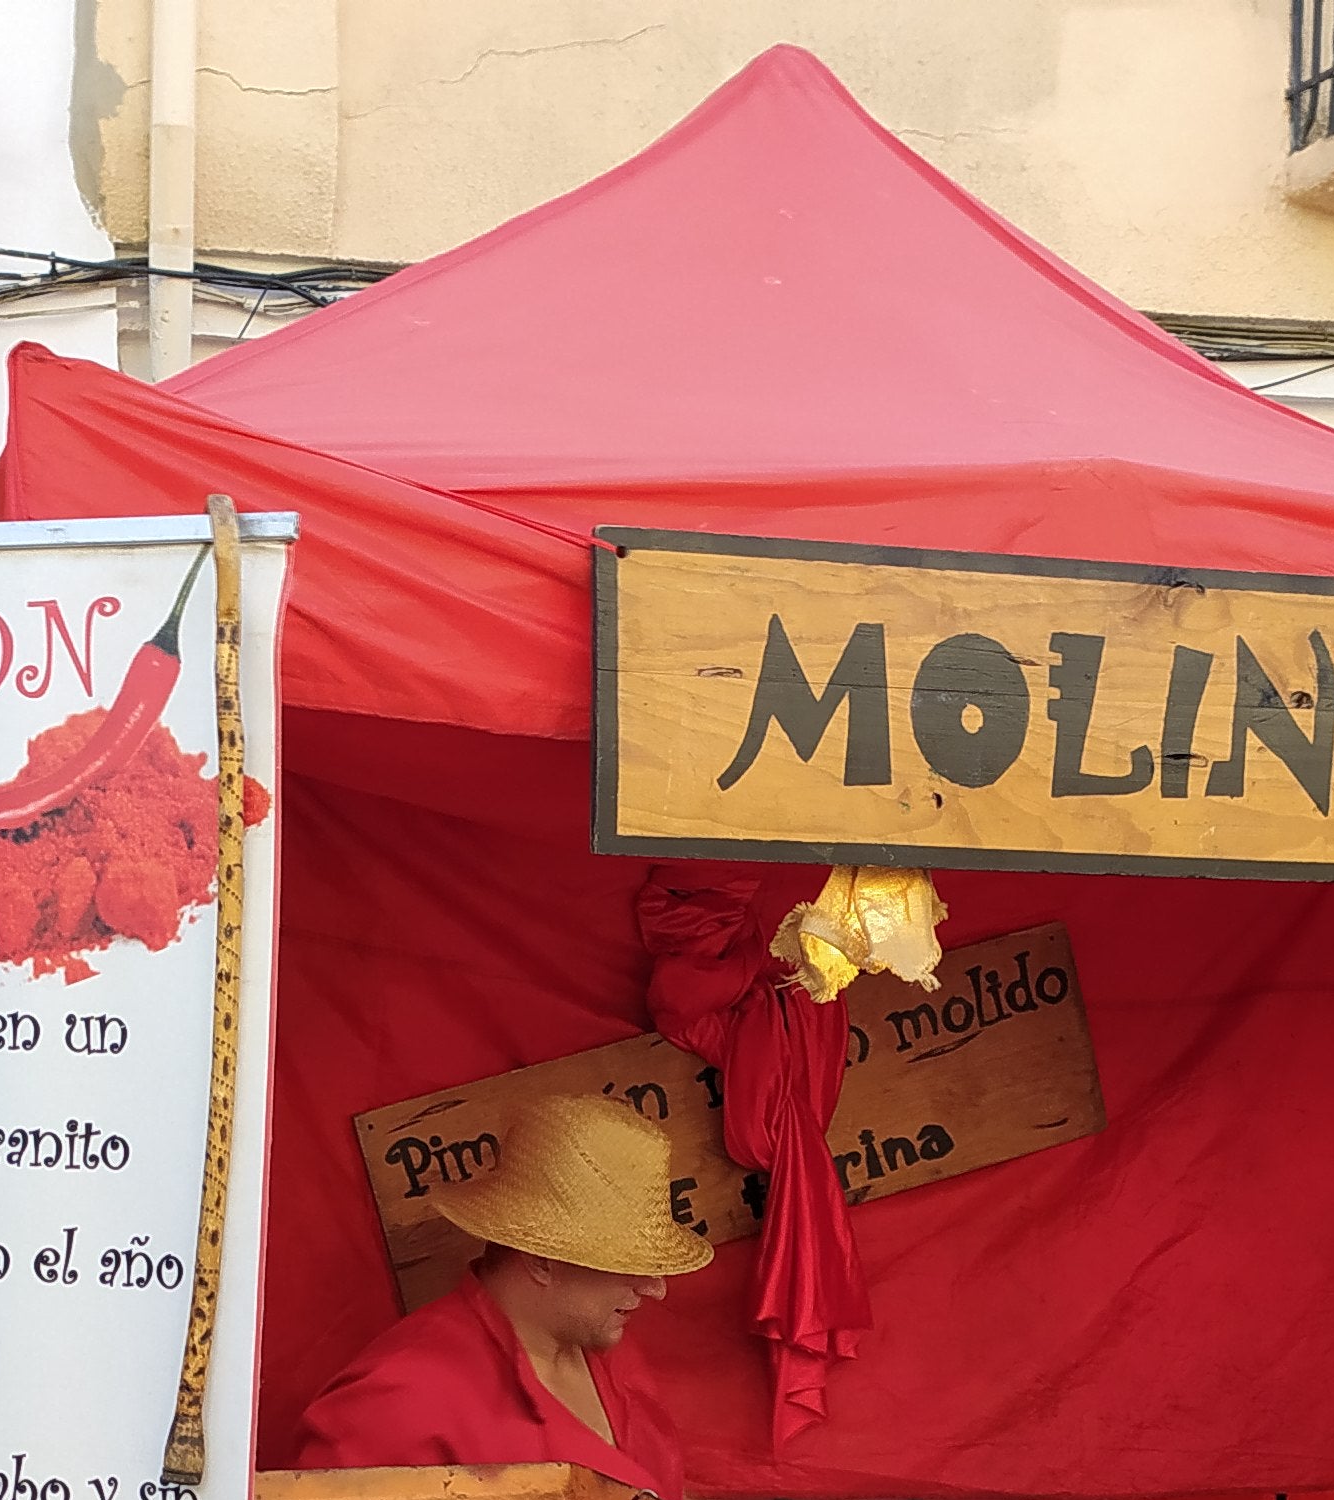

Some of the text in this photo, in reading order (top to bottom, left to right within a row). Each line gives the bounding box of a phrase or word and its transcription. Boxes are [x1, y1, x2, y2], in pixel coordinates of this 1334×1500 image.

[884, 950, 1069, 1052] molido
[65, 1013, 128, 1055] un
[33, 1227, 78, 1285] el
[99, 1235, 184, 1290] año
